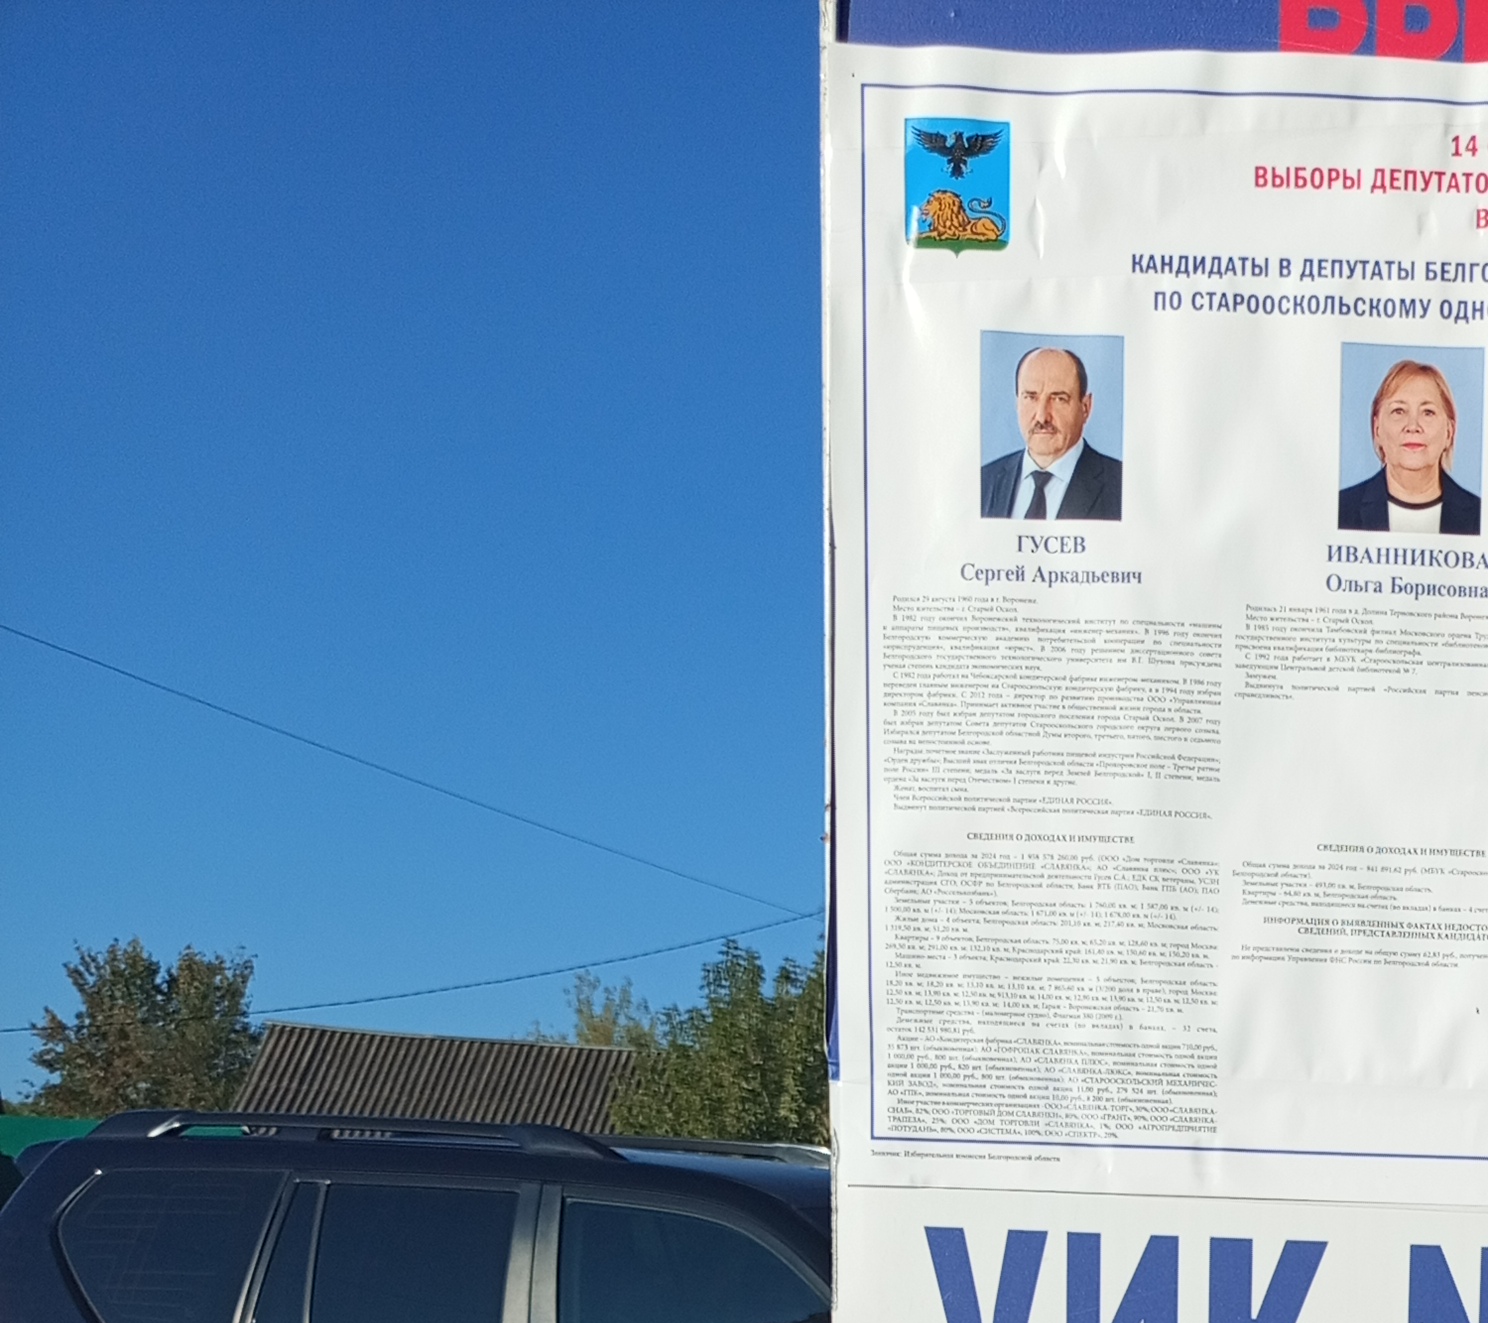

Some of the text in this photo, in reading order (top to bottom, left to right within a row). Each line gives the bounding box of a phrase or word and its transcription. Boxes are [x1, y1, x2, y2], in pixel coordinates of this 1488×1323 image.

[1452, 136, 1478, 156] 14
[1255, 166, 1361, 189] ВЫБОРЫ
[1132, 254, 1269, 278] КАНДИДАТЫ
[1279, 258, 1291, 277] В
[1300, 259, 1415, 281] ДЕПУТАТЫ
[1154, 291, 1182, 311] ПО
[1191, 292, 1431, 318] СТАРООСКОЛЬСКОМУ
[1018, 535, 1086, 554] ГУСЕВ
[1328, 545, 1488, 569] ИВАННИКОВА
[961, 563, 1141, 587] Сергей Аркадьевич
[1326, 574, 1488, 599] Ольга Борисовна
